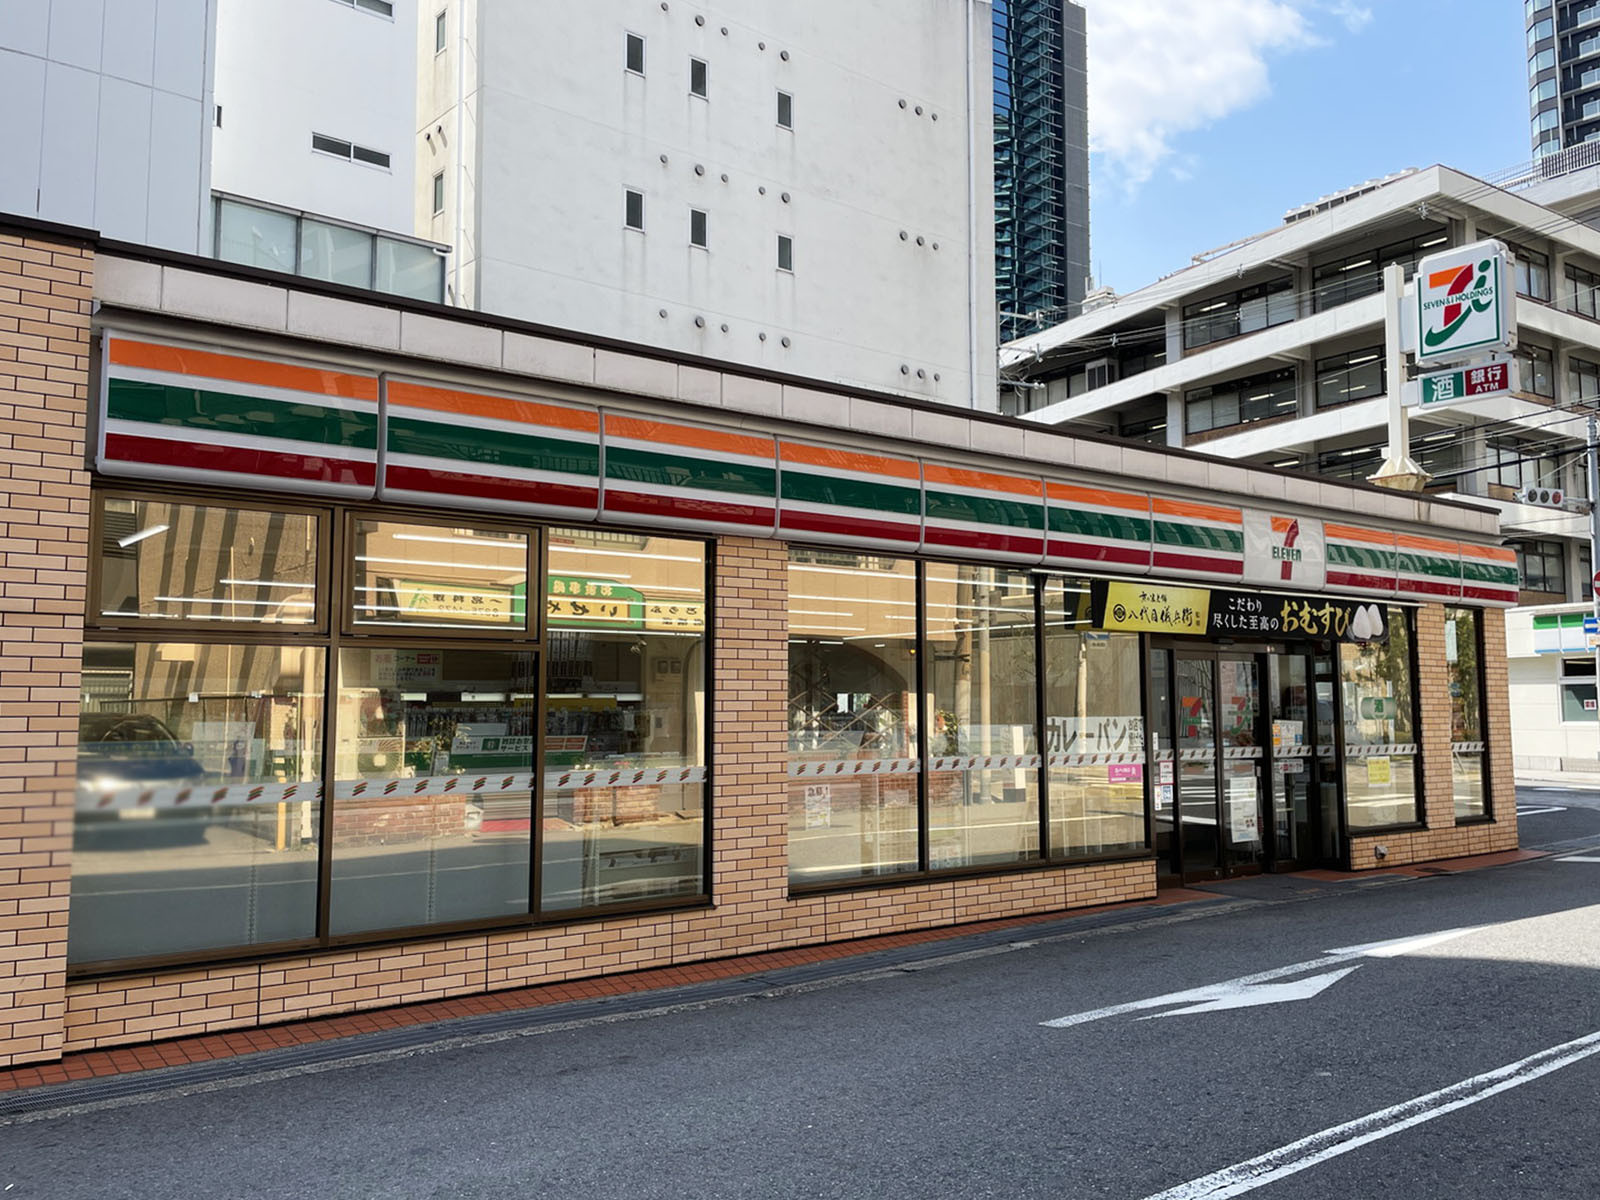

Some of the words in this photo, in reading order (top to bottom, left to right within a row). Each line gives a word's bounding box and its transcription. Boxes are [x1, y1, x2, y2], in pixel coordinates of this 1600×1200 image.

[1455, 287, 1494, 304] HOLDINGS
[1470, 366, 1502, 385] 銀行
[1432, 374, 1455, 402] 酒
[1475, 381, 1499, 394] ATM
[1227, 597, 1263, 612] こだわり
[1212, 611, 1280, 632] 尽くした至高の
[1280, 600, 1353, 637] おむすび
[1047, 717, 1128, 753] カレーパン
